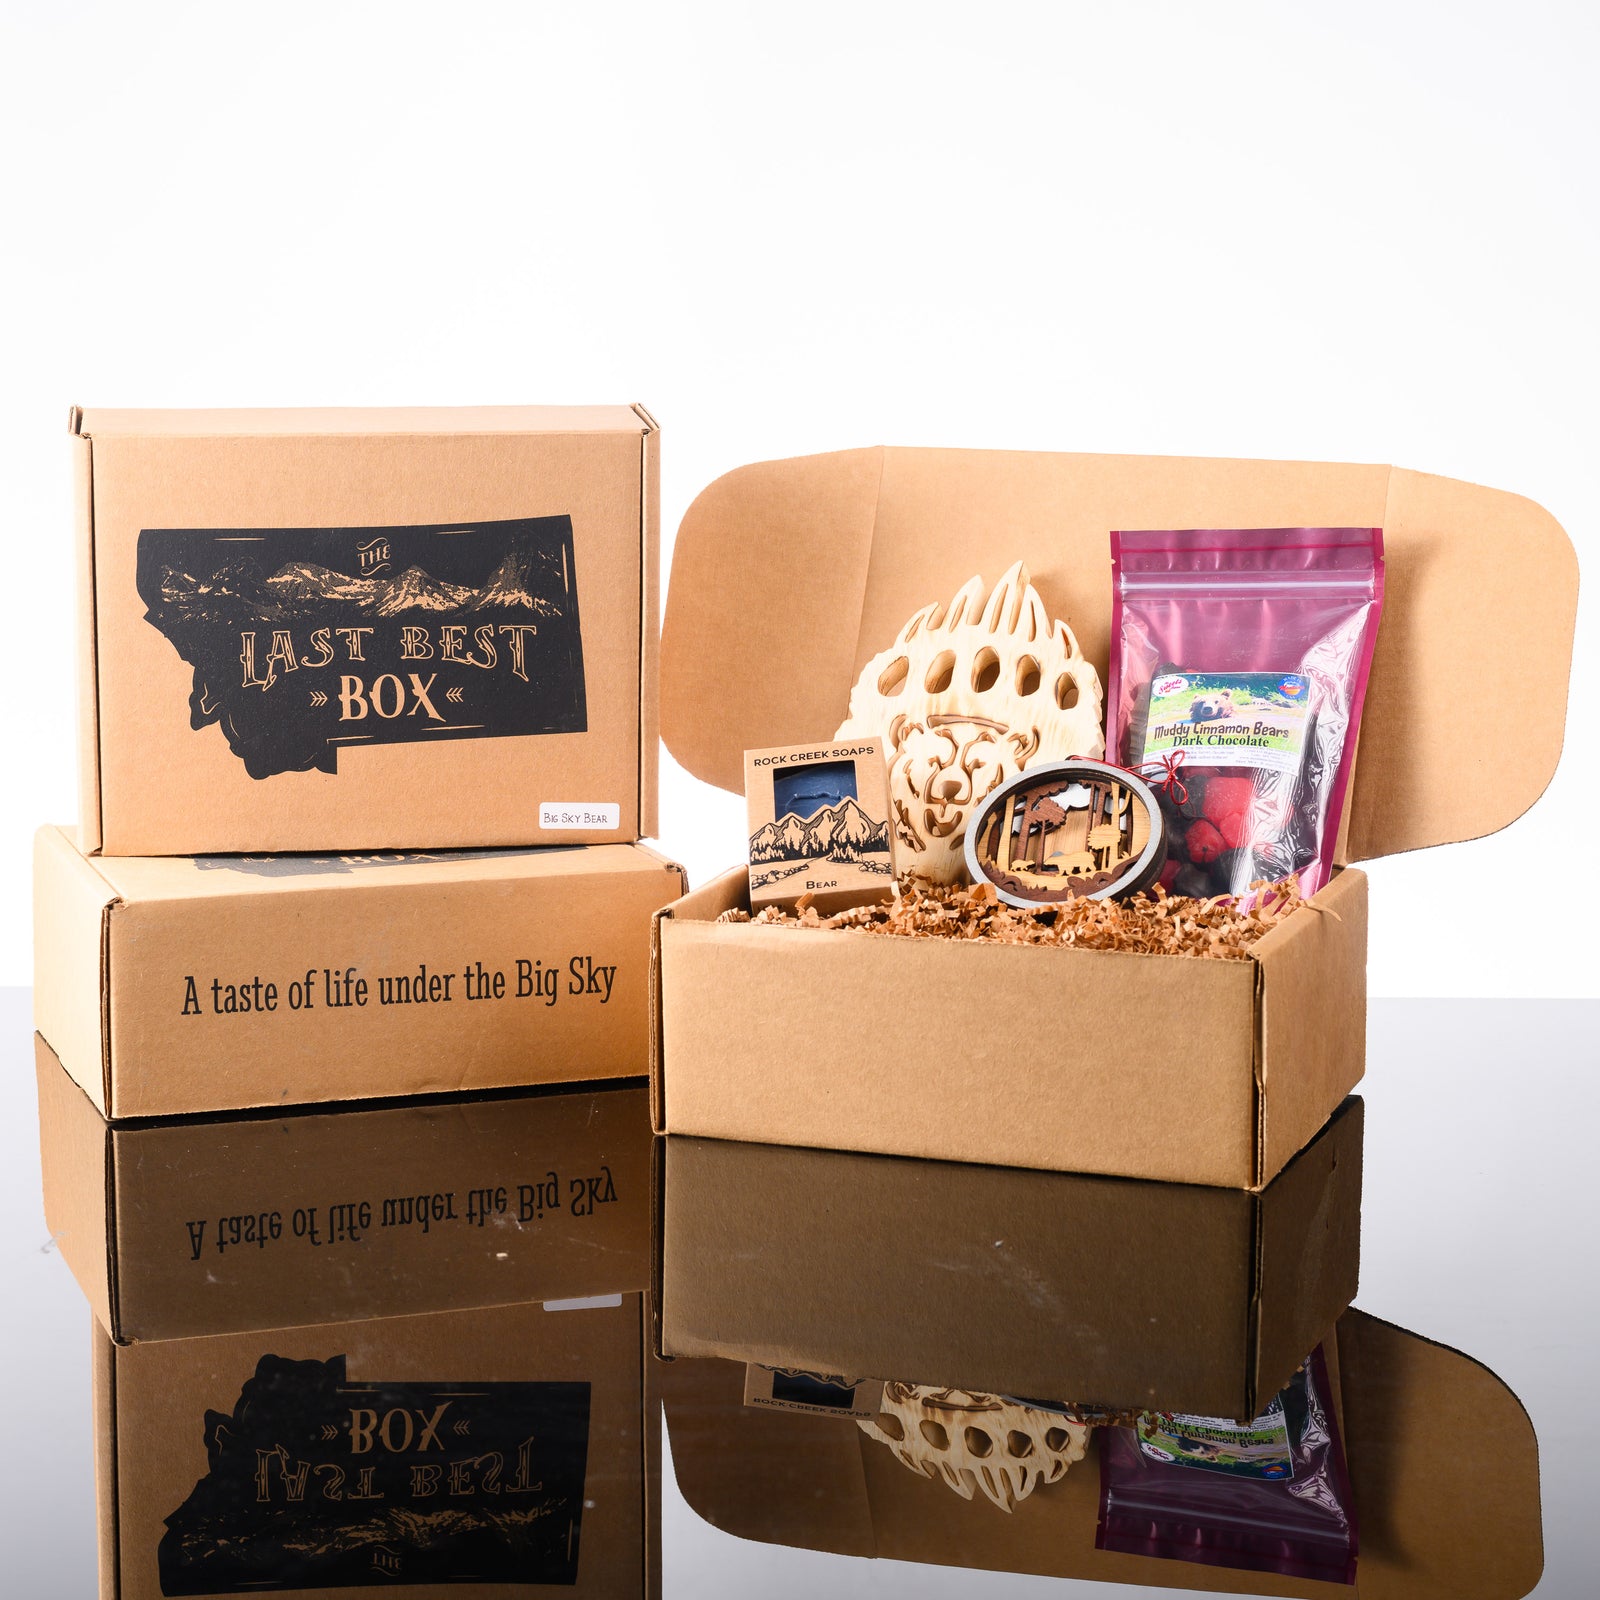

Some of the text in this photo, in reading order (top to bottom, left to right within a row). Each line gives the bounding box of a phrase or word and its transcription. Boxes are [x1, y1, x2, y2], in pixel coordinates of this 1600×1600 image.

[357, 544, 391, 567] THE
[240, 624, 537, 691] LAST BEST
[338, 673, 446, 722] BOX
[1154, 721, 1289, 739] Muddy Cinnamon Bears
[1173, 735, 1270, 747] Dark Chocolate
[754, 747, 874, 767] ROCK CREEK SOAPS
[181, 956, 617, 1015] A taste of life under the Big Sky
